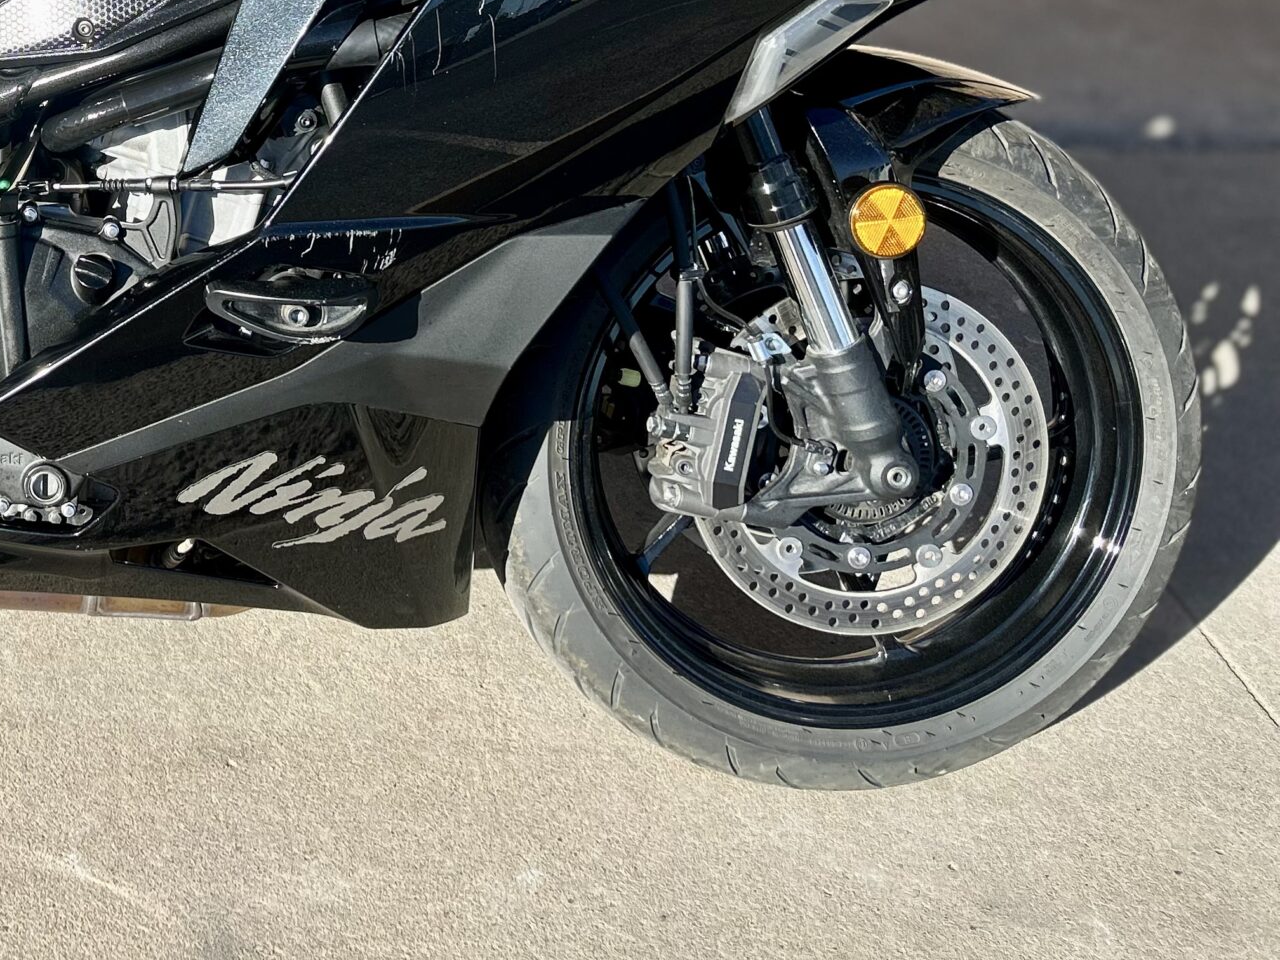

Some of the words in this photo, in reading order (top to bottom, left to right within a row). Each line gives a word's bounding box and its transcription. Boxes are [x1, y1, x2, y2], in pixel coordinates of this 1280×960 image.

[723, 417, 746, 473] Kawasaki
[177, 451, 447, 549] Ninja
[555, 470, 609, 613] SPORTMAX
